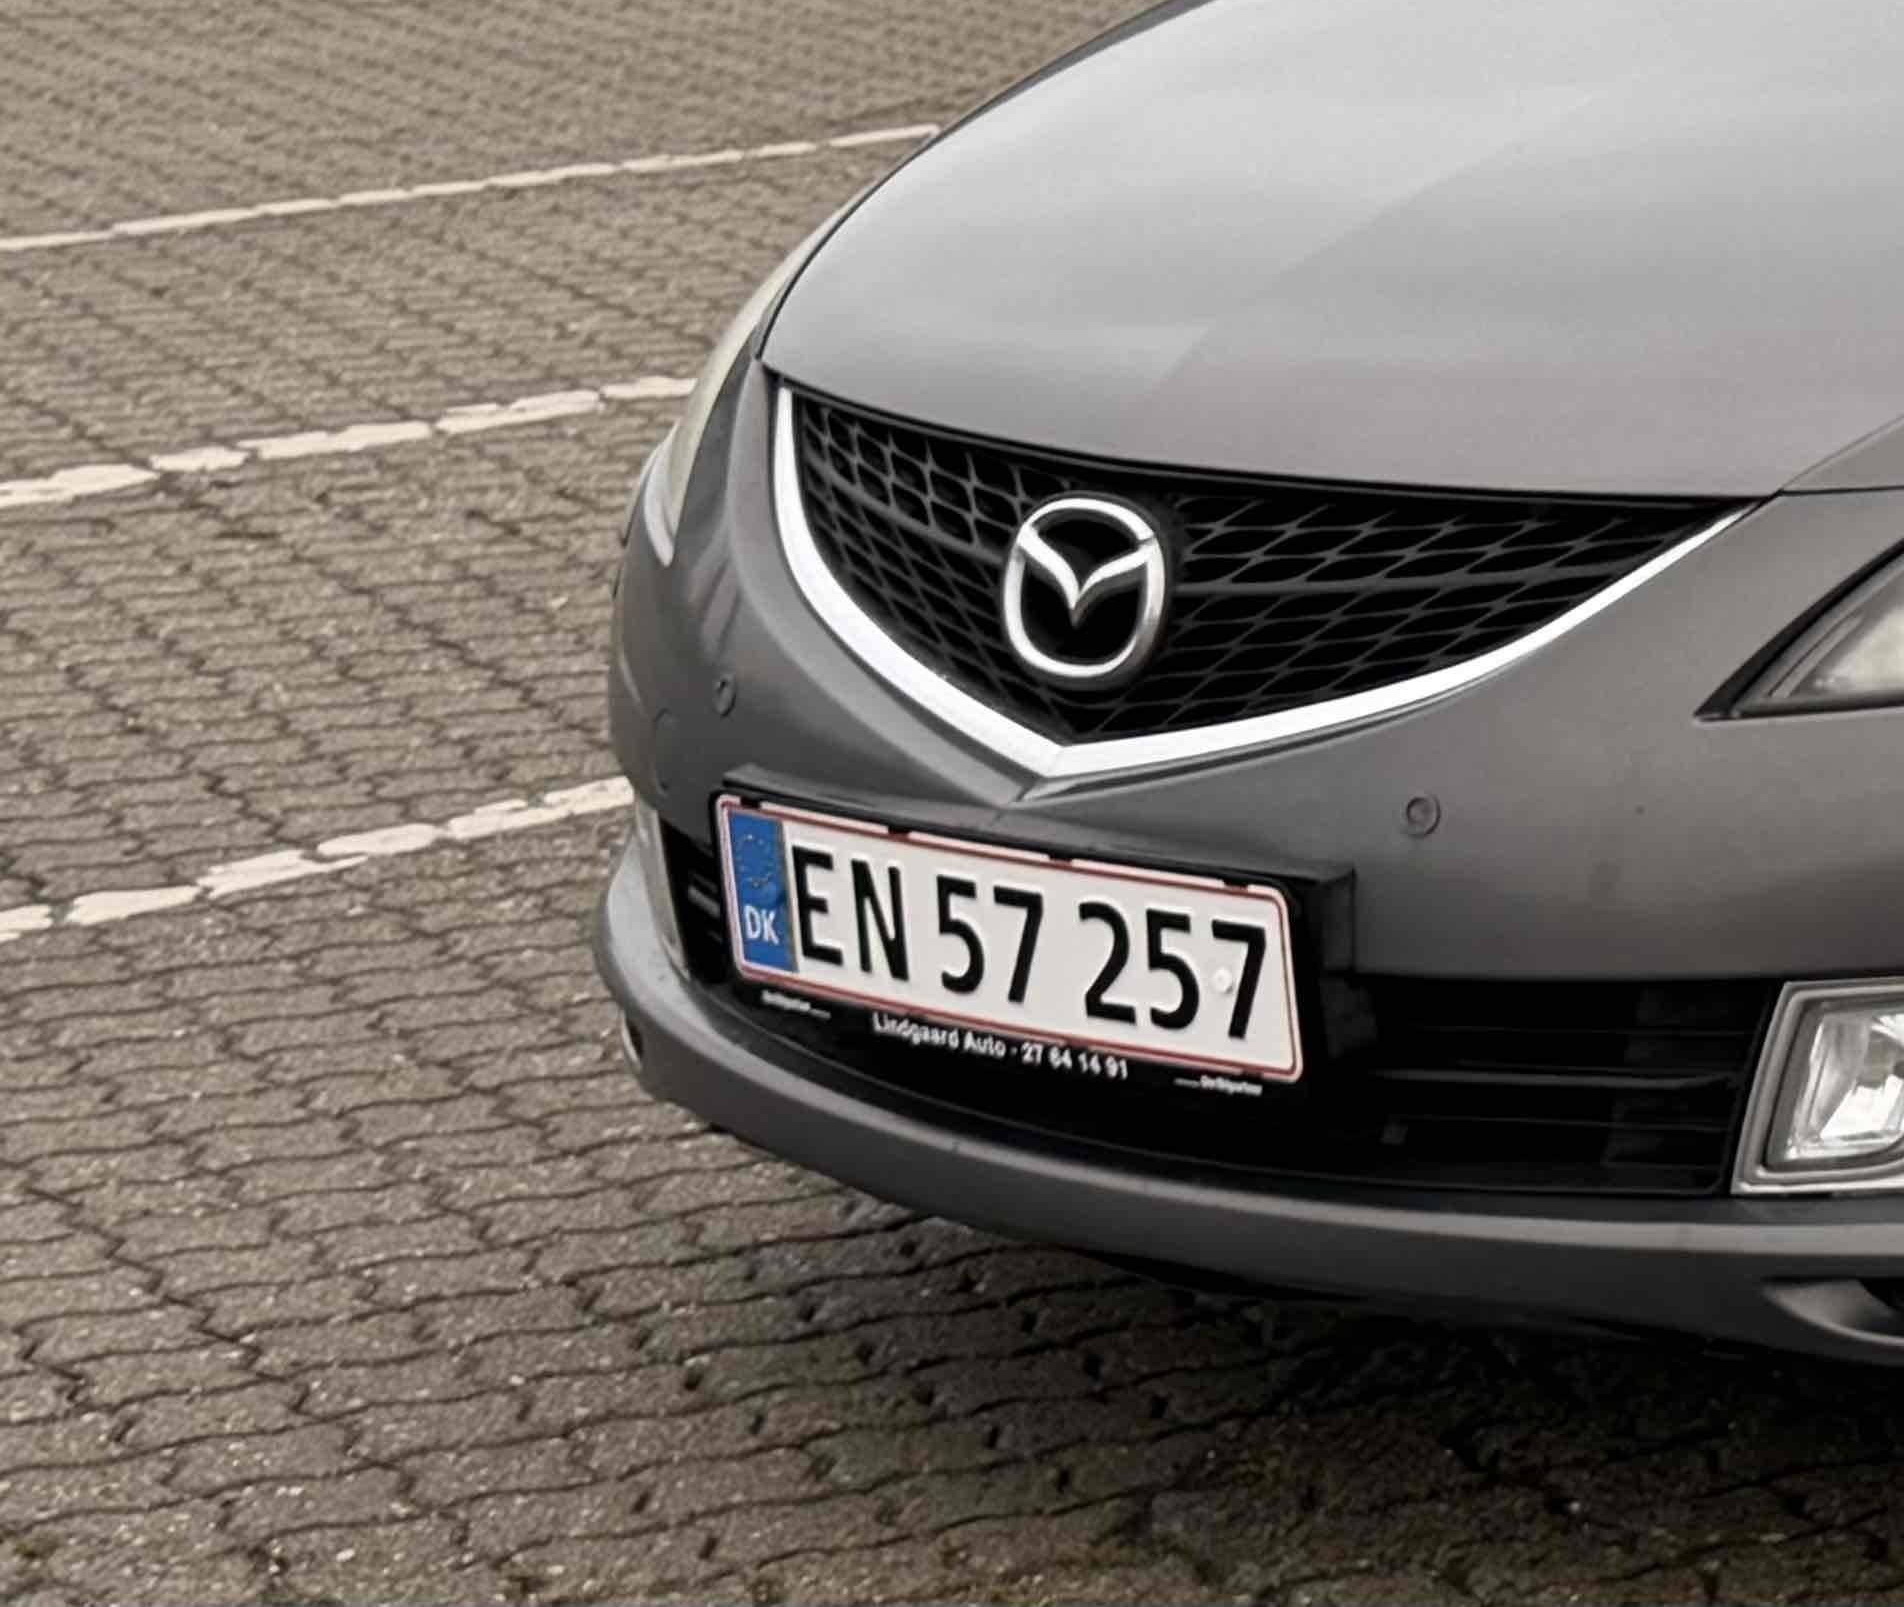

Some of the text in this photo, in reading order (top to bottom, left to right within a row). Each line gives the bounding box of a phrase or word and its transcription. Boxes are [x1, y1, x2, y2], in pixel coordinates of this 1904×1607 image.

[743, 904, 780, 945] DK
[792, 845, 1266, 1039] EN 57 257
[872, 1011, 959, 1049] Lindgaard
[963, 1029, 1006, 1058] Auto
[1021, 1041, 1044, 1066] 27
